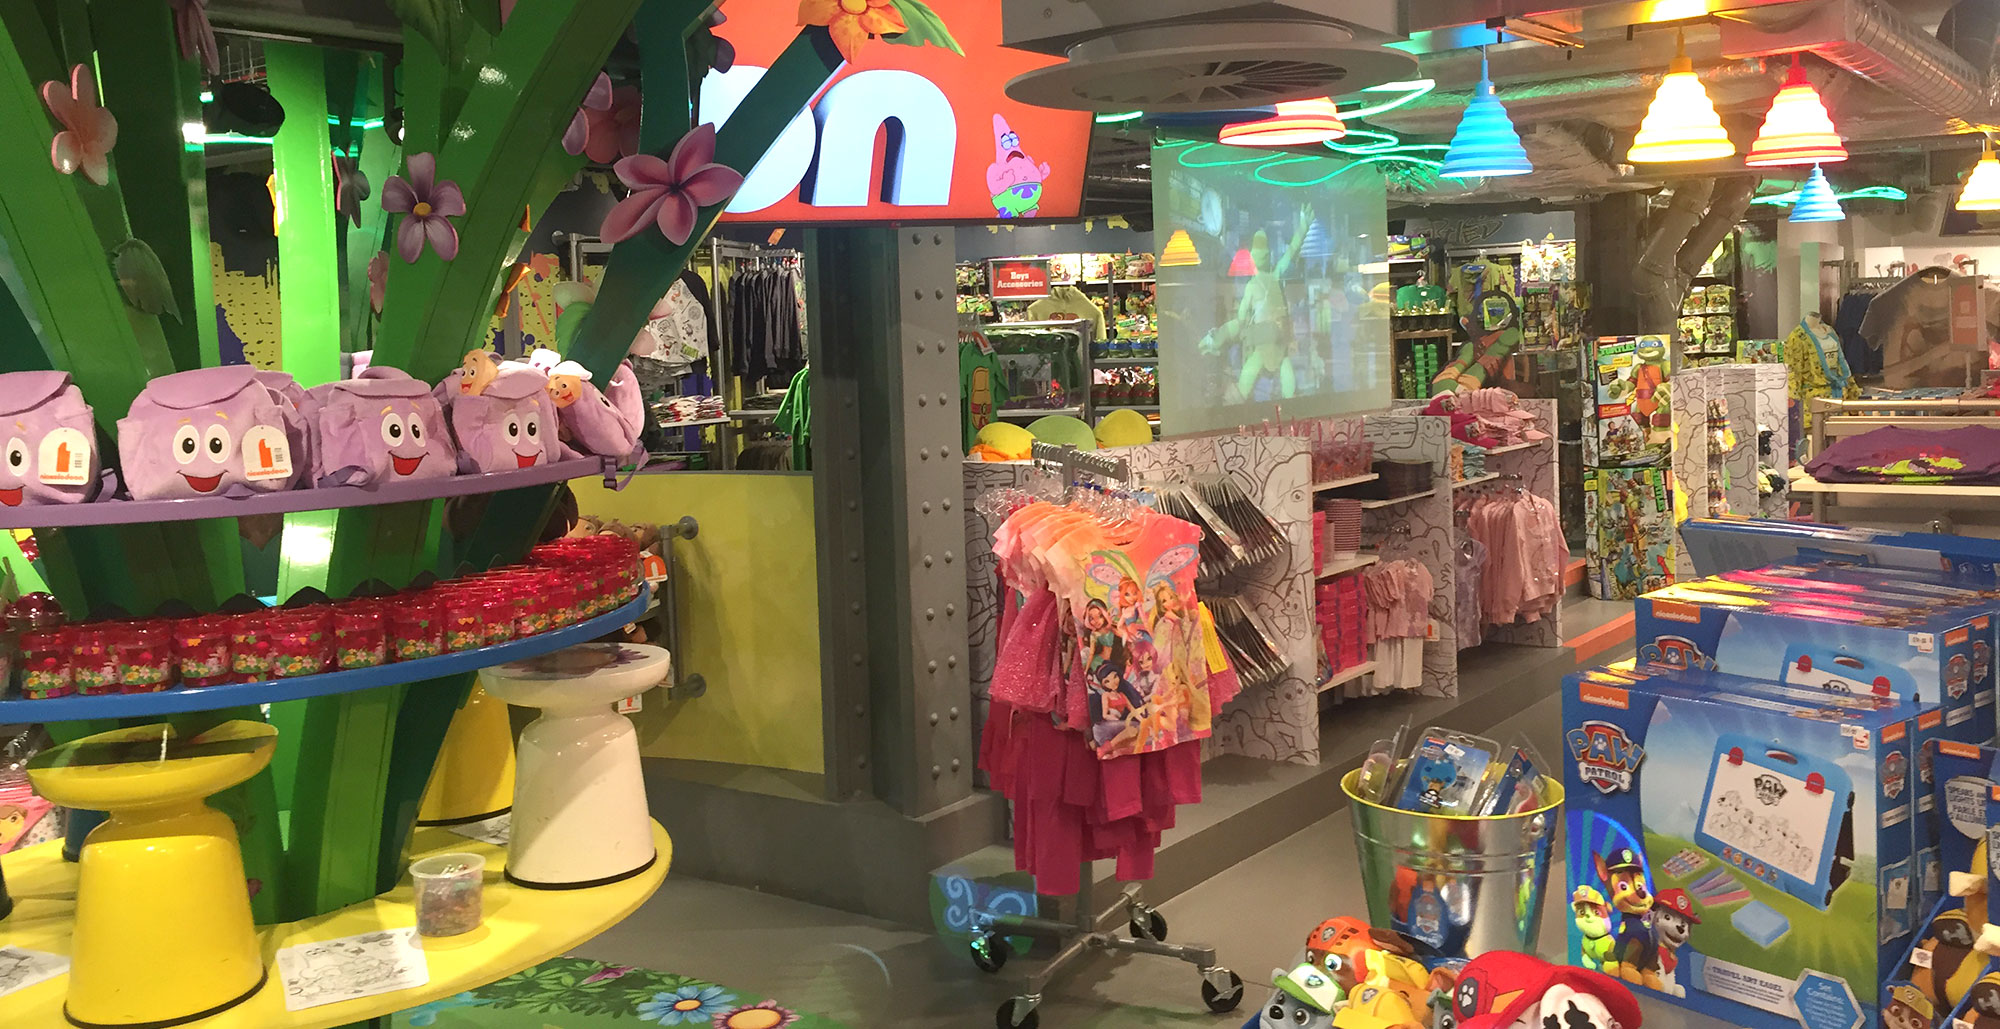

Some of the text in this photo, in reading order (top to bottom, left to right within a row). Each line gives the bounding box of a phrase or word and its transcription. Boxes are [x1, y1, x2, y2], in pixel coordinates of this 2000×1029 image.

[1010, 271, 1029, 280] Boys
[997, 280, 1043, 288] Accessories
[246, 467, 289, 477] nickelodeon
[1583, 693, 1626, 707] nickelodeon
[1566, 728, 1645, 773] PAW
[1584, 766, 1625, 784] PATROL
[1754, 777, 1788, 797] PAW
